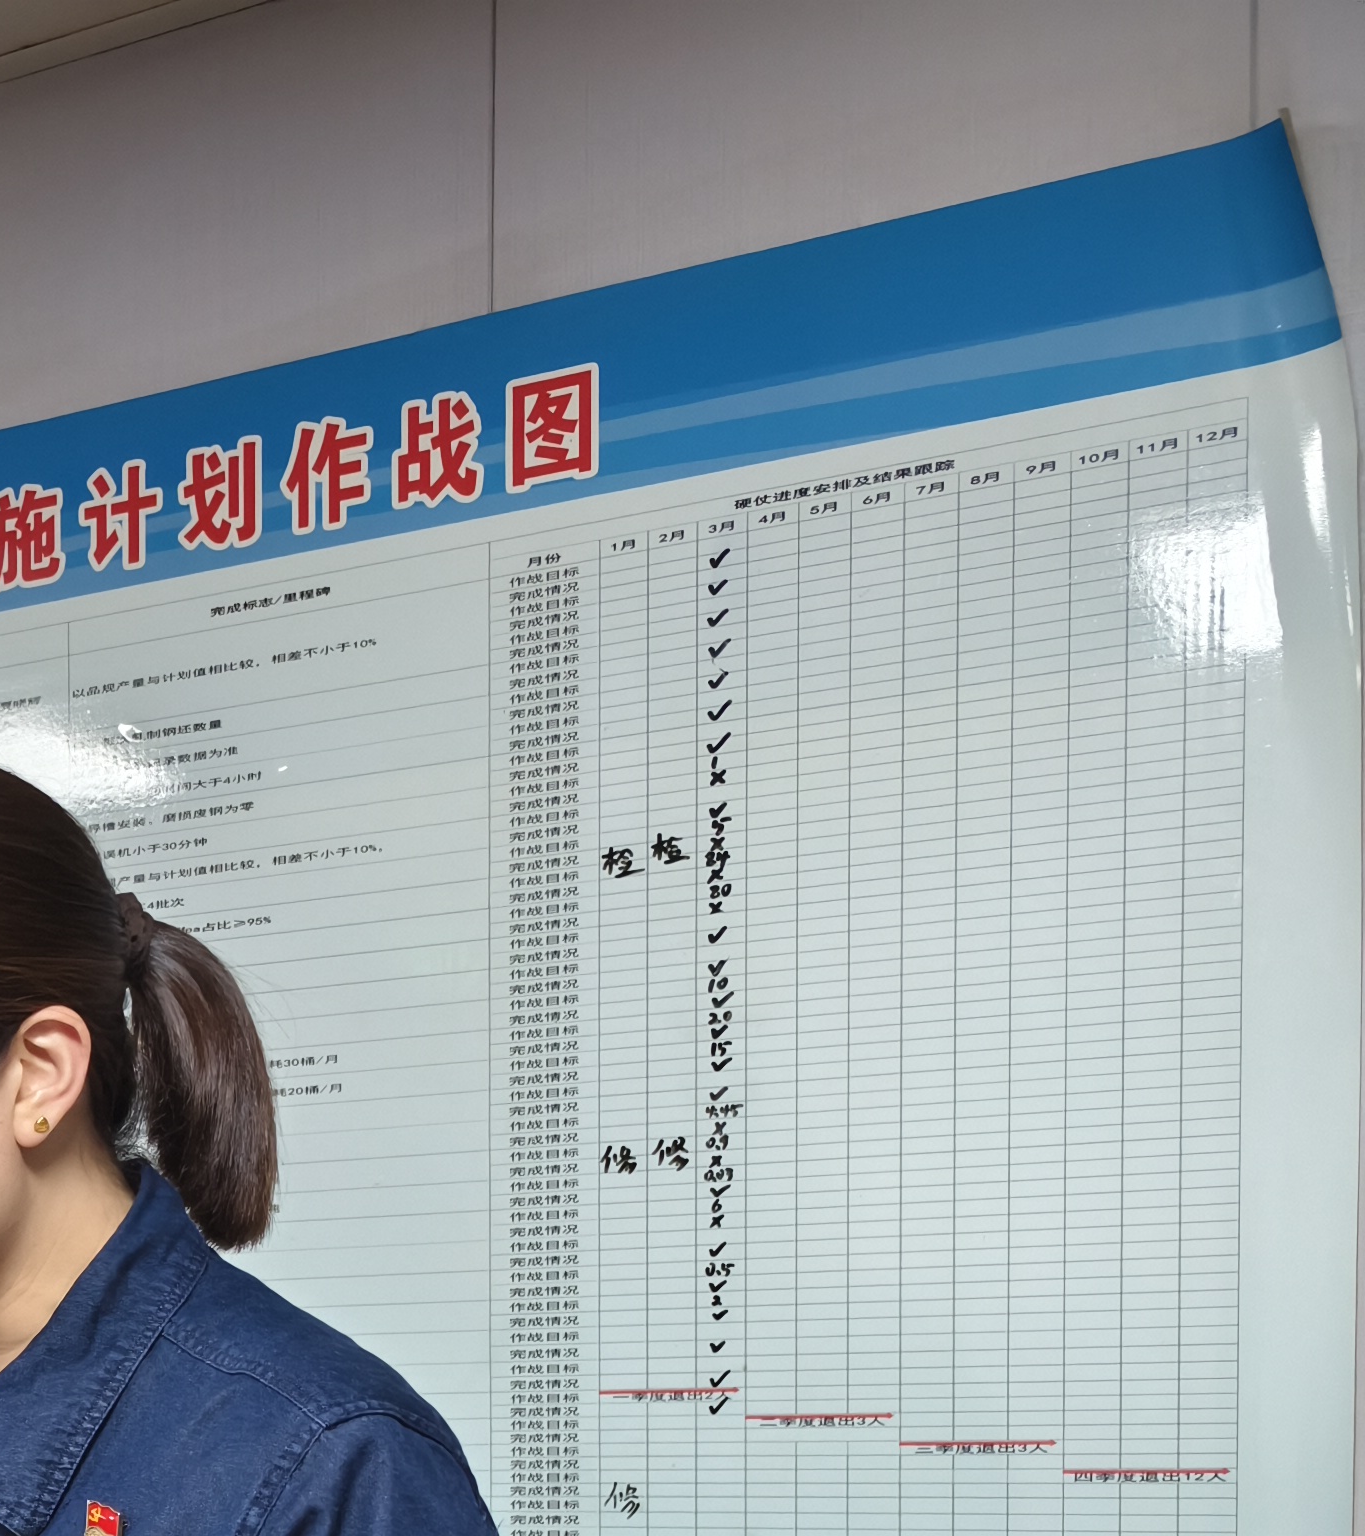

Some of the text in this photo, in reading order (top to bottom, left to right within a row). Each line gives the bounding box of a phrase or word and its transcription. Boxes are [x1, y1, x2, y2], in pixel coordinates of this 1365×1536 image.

[1196, 425, 1239, 443] 12月
[1136, 436, 1178, 454] 11月
[1078, 448, 1119, 465] 10月
[1025, 459, 1056, 475] 9月
[733, 457, 957, 511] 硬仗进度安排及结果跟踪
[969, 470, 1000, 485] 8月
[915, 480, 946, 496] 7月
[862, 490, 891, 505] 6月
[809, 500, 837, 515] 5月
[757, 510, 786, 525] 4月
[708, 520, 734, 534] 3月
[659, 529, 685, 543] 2月
[611, 539, 636, 552] 1月
[527, 552, 561, 568] 月份
[509, 566, 579, 588] 作战目标
[210, 586, 331, 618] 完成标志/里程碑
[509, 595, 579, 617] 作战目标
[509, 623, 579, 645] 作战目标
[509, 652, 579, 674] 作战目标
[509, 684, 579, 705] 作战目标
[509, 715, 579, 735] 作战目标
[509, 745, 579, 766] 作战目标
[509, 776, 579, 797] 作战目标
[509, 807, 579, 827] 作战目标
[509, 838, 579, 858] 作战目标
[509, 869, 579, 889] 作战目标
[509, 900, 579, 919] 作战目标
[509, 931, 579, 950] 作战目标
[509, 962, 579, 980] 作战目标
[708, 976, 729, 993] 10
[509, 993, 579, 1011] 作战目标
[509, 1023, 579, 1041] 作战目标
[509, 1054, 579, 1071] 作战目标
[509, 1085, 579, 1102] 作战目标
[509, 1115, 579, 1132] 作战目标
[509, 1146, 579, 1162] 作战目标
[509, 1177, 579, 1193] 作战目标
[509, 1222, 579, 1238] 完成情况
[509, 1253, 579, 1268] 完成情况
[509, 1284, 579, 1298] 完成情况
[509, 1314, 579, 1328] 完成情况
[509, 1346, 579, 1360] 完成情况
[509, 1377, 579, 1391] 完成情况
[511, 1405, 579, 1418] 完成情况
[511, 1431, 579, 1444] 完成情况
[511, 1458, 579, 1471] 完成情况
[511, 1484, 579, 1497] 完成情况
[511, 1513, 579, 1526] 完成情况
